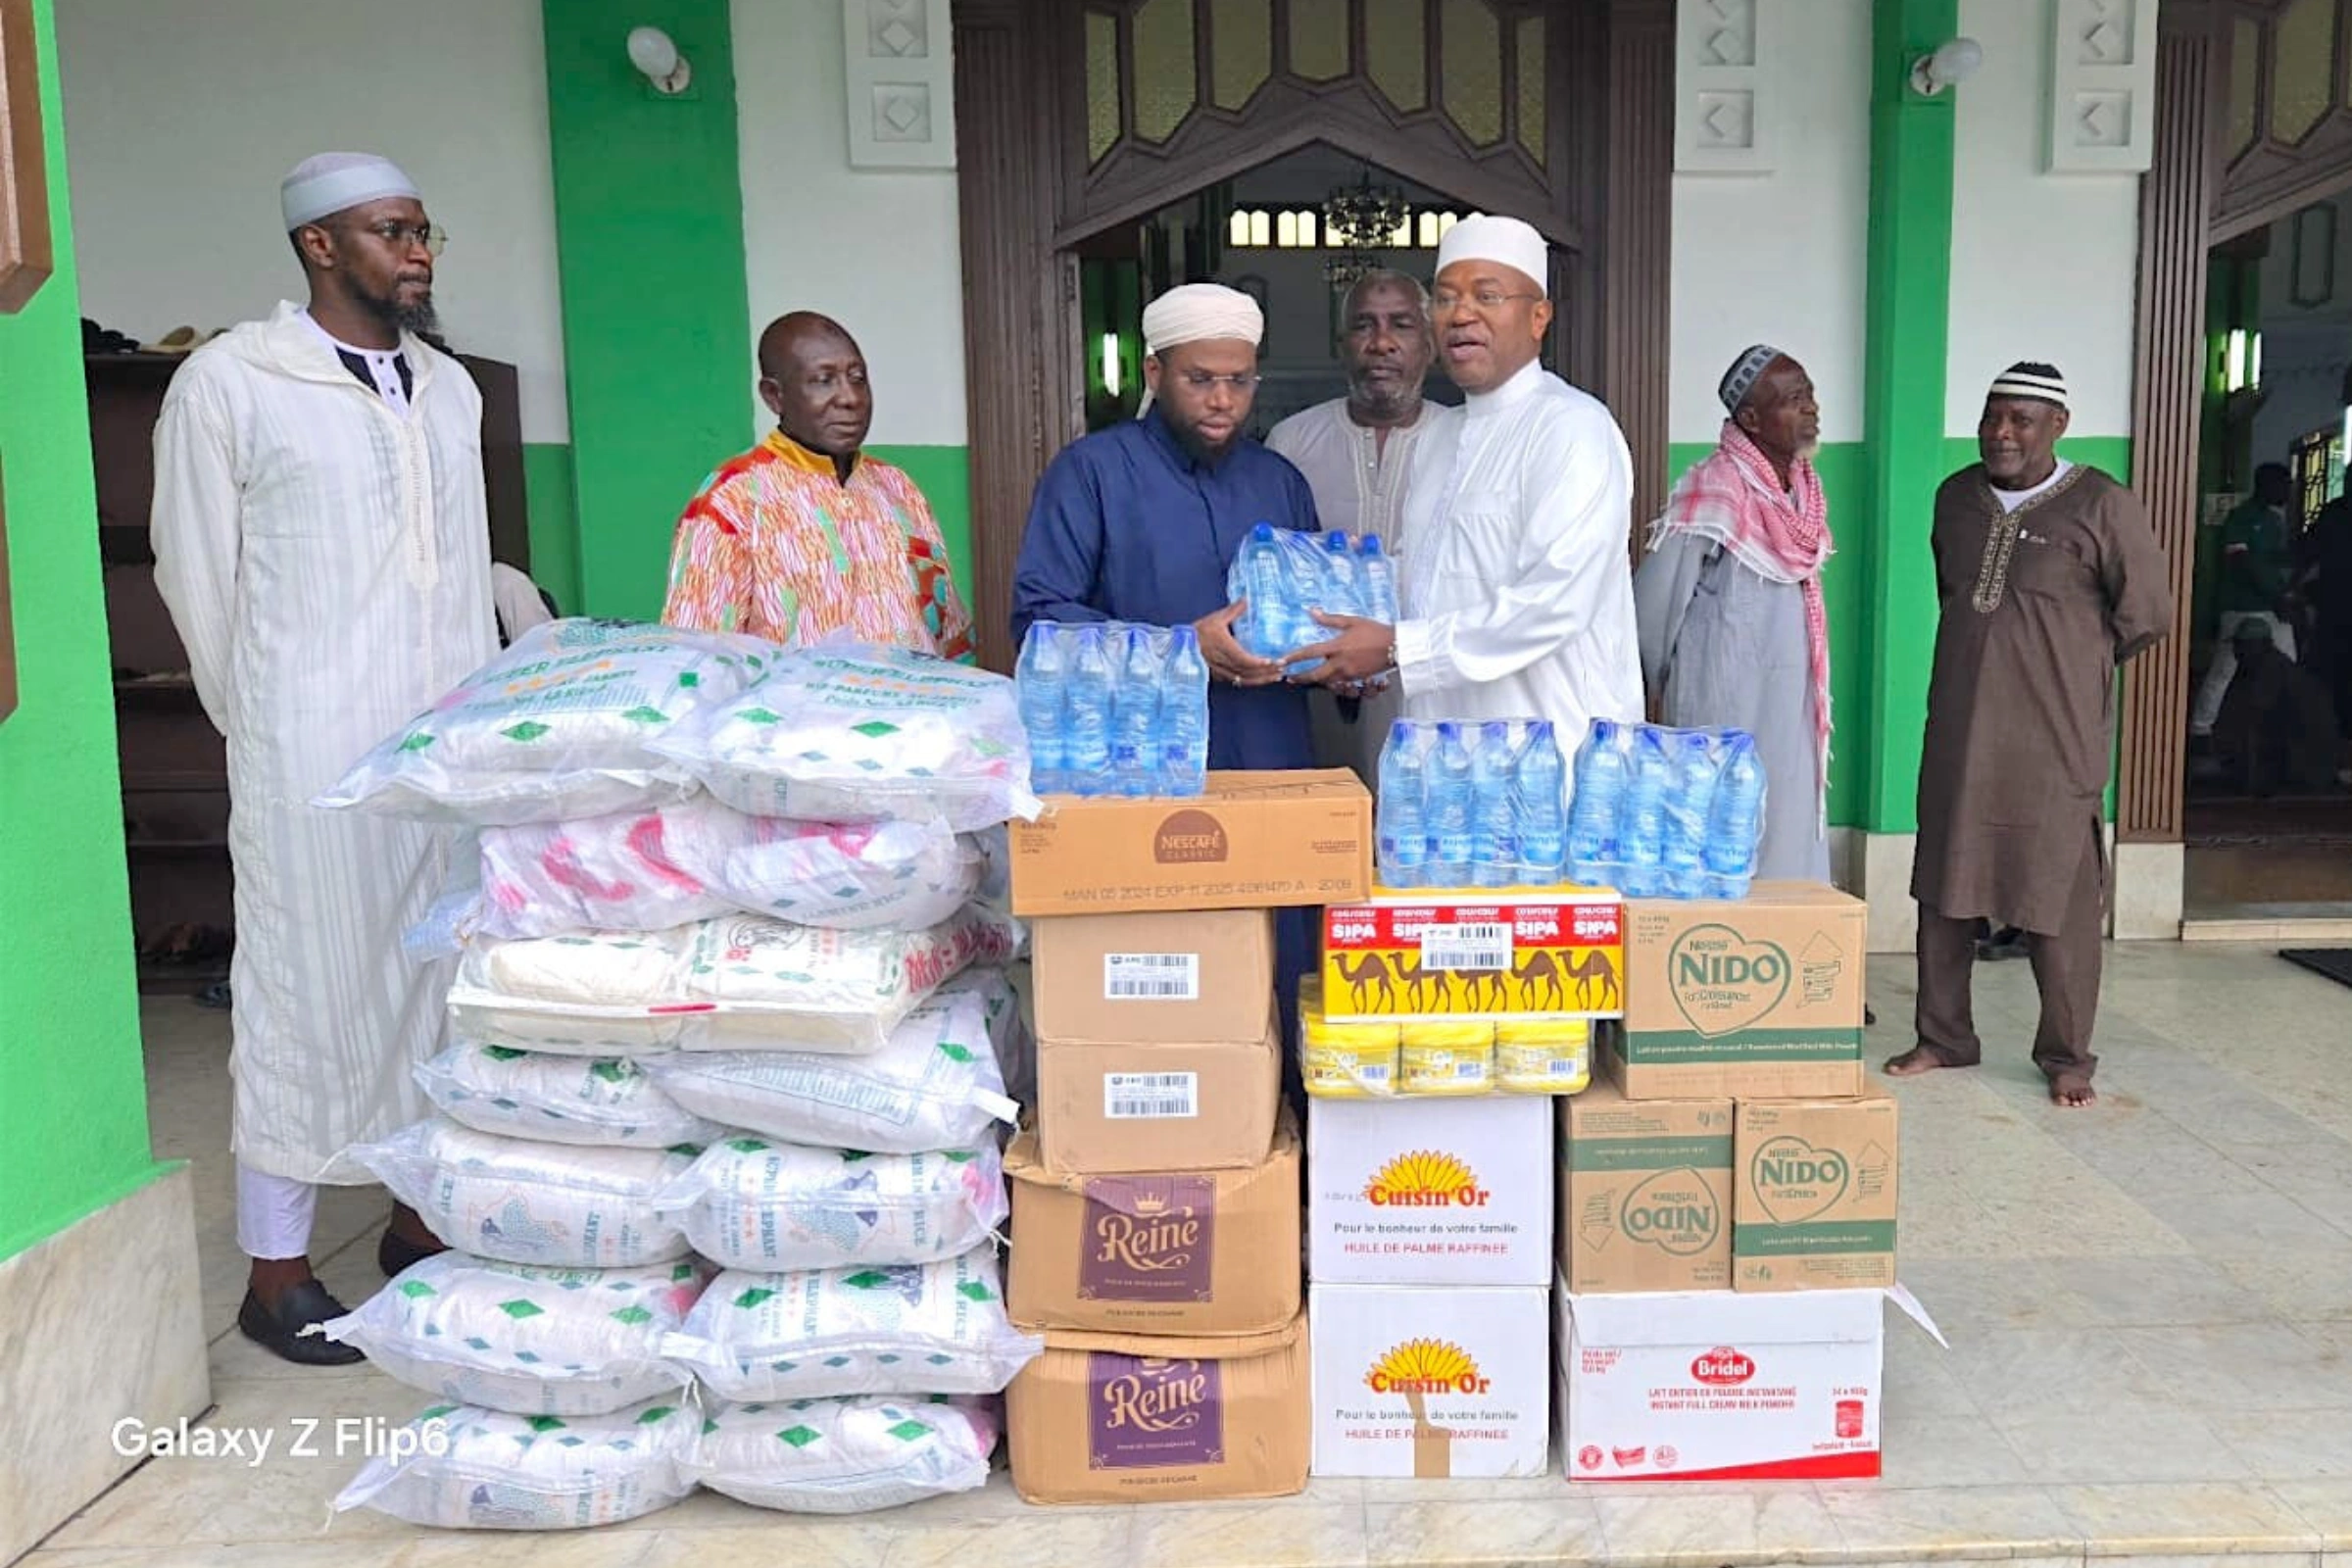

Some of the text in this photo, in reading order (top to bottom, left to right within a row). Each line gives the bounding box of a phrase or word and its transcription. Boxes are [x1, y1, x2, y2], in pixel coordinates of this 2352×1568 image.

[1331, 923, 1377, 939] SIPA
[1392, 923, 1422, 938] SIP
[1515, 921, 1560, 937] SIPA
[1573, 920, 1617, 936] SIPA
[1678, 953, 1782, 987] NIDO
[1760, 1158, 1842, 1186] NIDO
[1627, 1205, 1713, 1233] NIDO
[1334, 1222, 1360, 1233] Pour
[1378, 1222, 1426, 1233] bonheur
[1430, 1222, 1444, 1233] de
[1447, 1223, 1476, 1233] votre
[1480, 1222, 1518, 1233] famille
[1097, 1213, 1199, 1270] Reine
[1345, 1244, 1380, 1253] HUILE
[1384, 1244, 1399, 1253] DE
[1403, 1244, 1444, 1253] PALME
[1698, 1359, 1747, 1375] Bridel
[1103, 1373, 1207, 1431] Reine
[1448, 1410, 1477, 1420] votre
[1346, 1430, 1381, 1439] HUILE
[1386, 1430, 1401, 1439] DE
